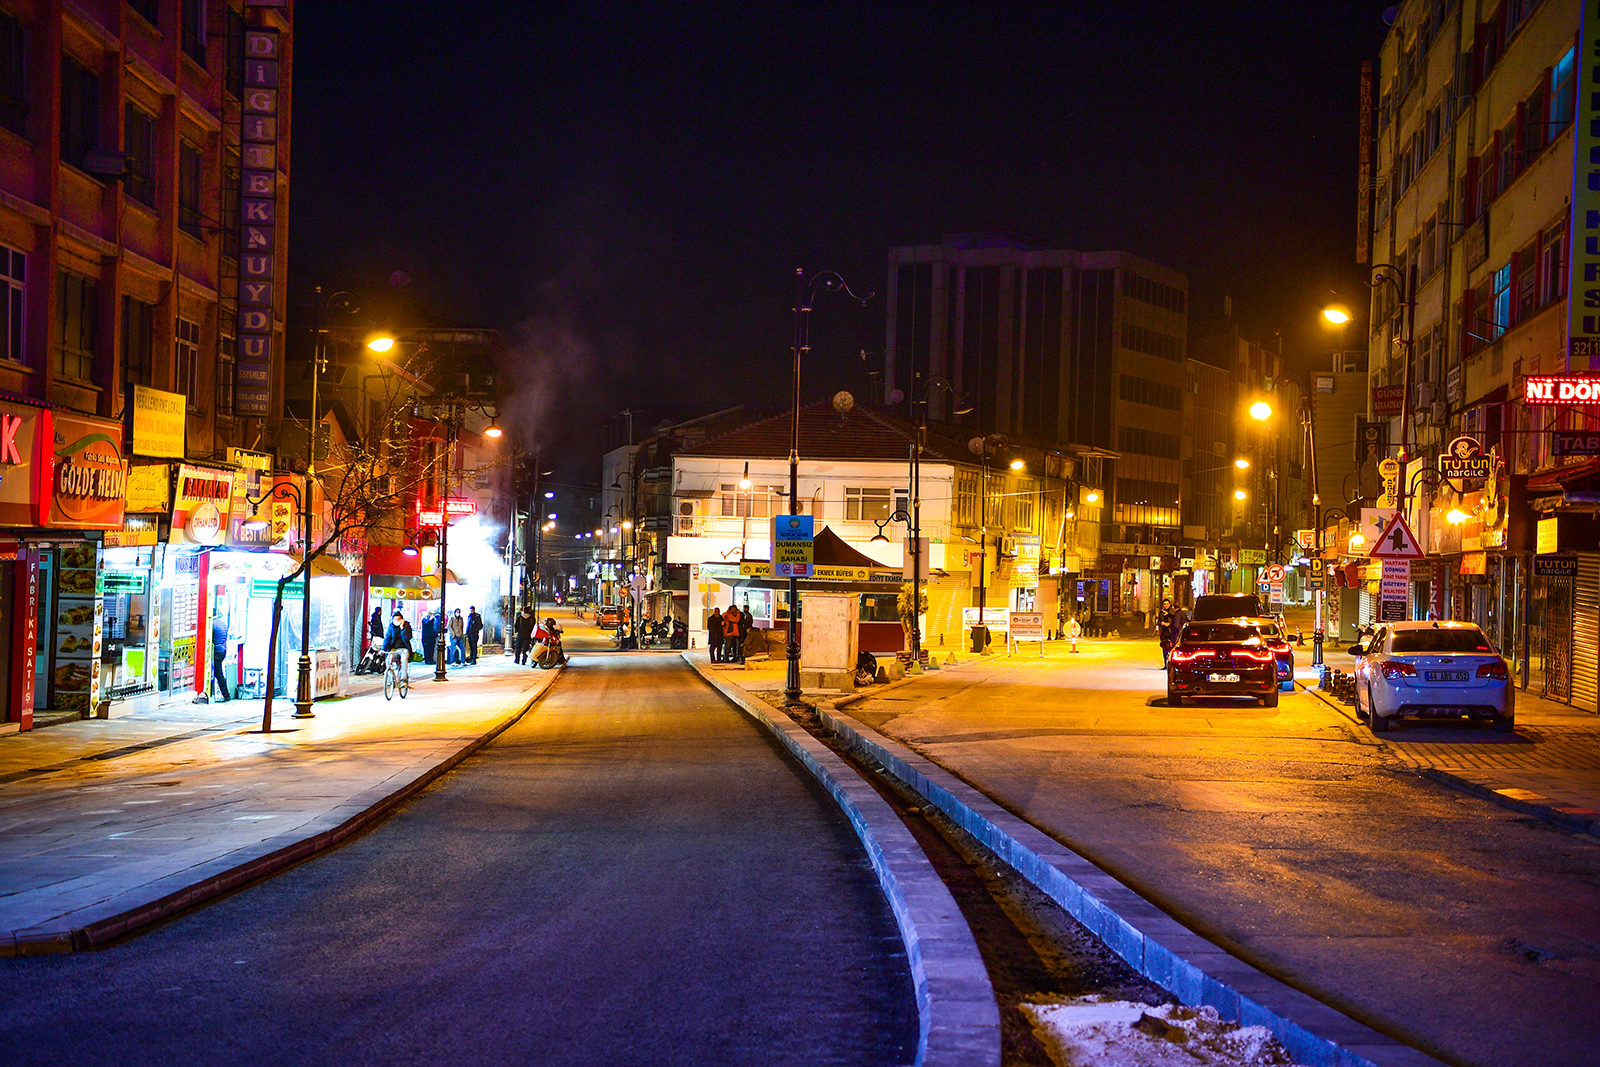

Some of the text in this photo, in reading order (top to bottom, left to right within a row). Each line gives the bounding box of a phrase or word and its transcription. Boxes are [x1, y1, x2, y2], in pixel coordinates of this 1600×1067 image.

[1573, 342, 1591, 355] 321
[1, 414, 22, 464] K
[60, 457, 96, 497] GÖZDE
[97, 468, 125, 498] HELVA
[755, 566, 770, 574] BÜYÜ
[1313, 560, 1322, 570] D
[817, 569, 836, 577] EKMEK
[836, 569, 854, 578] BÜFESİ
